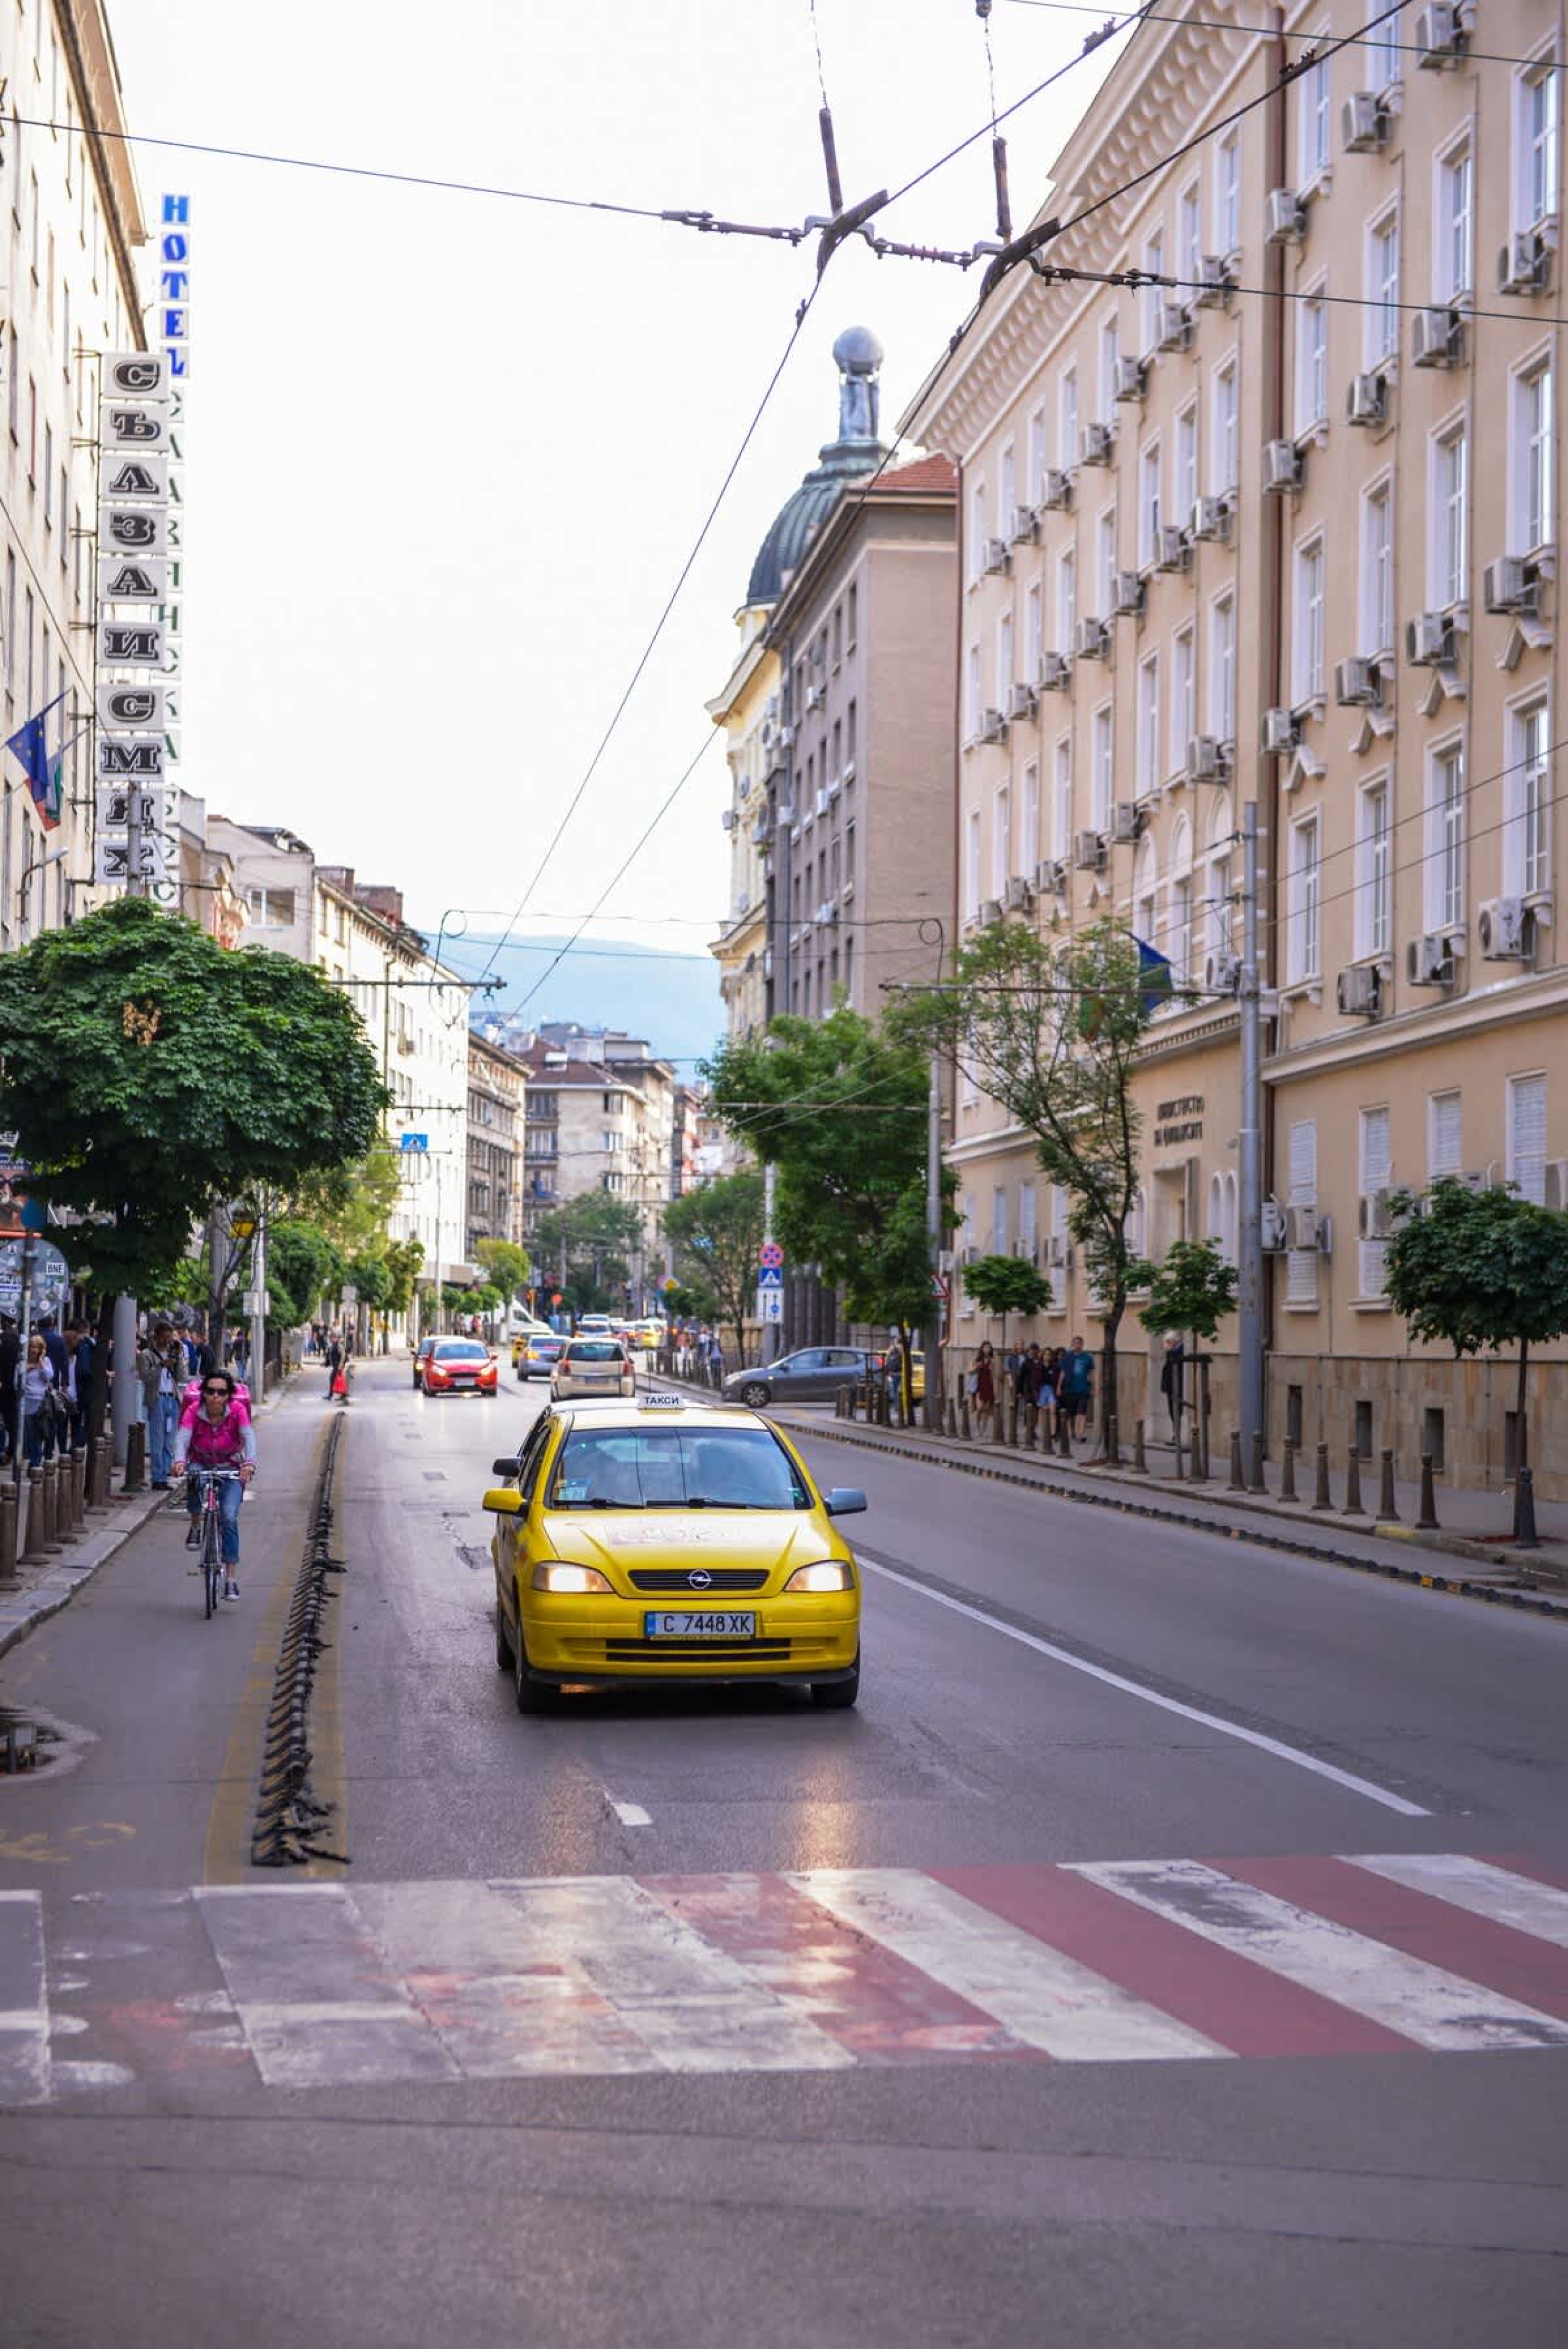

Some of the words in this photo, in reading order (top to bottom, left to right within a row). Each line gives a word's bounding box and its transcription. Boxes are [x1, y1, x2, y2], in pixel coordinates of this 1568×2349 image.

[162, 196, 188, 375] HOTEL
[108, 361, 160, 596] СЪЛЗА
[104, 628, 159, 660] И
[644, 1396, 679, 1405] ТАКСИ
[663, 1616, 675, 1632] C
[683, 1616, 725, 1632] 7448
[729, 1616, 751, 1632] XK
